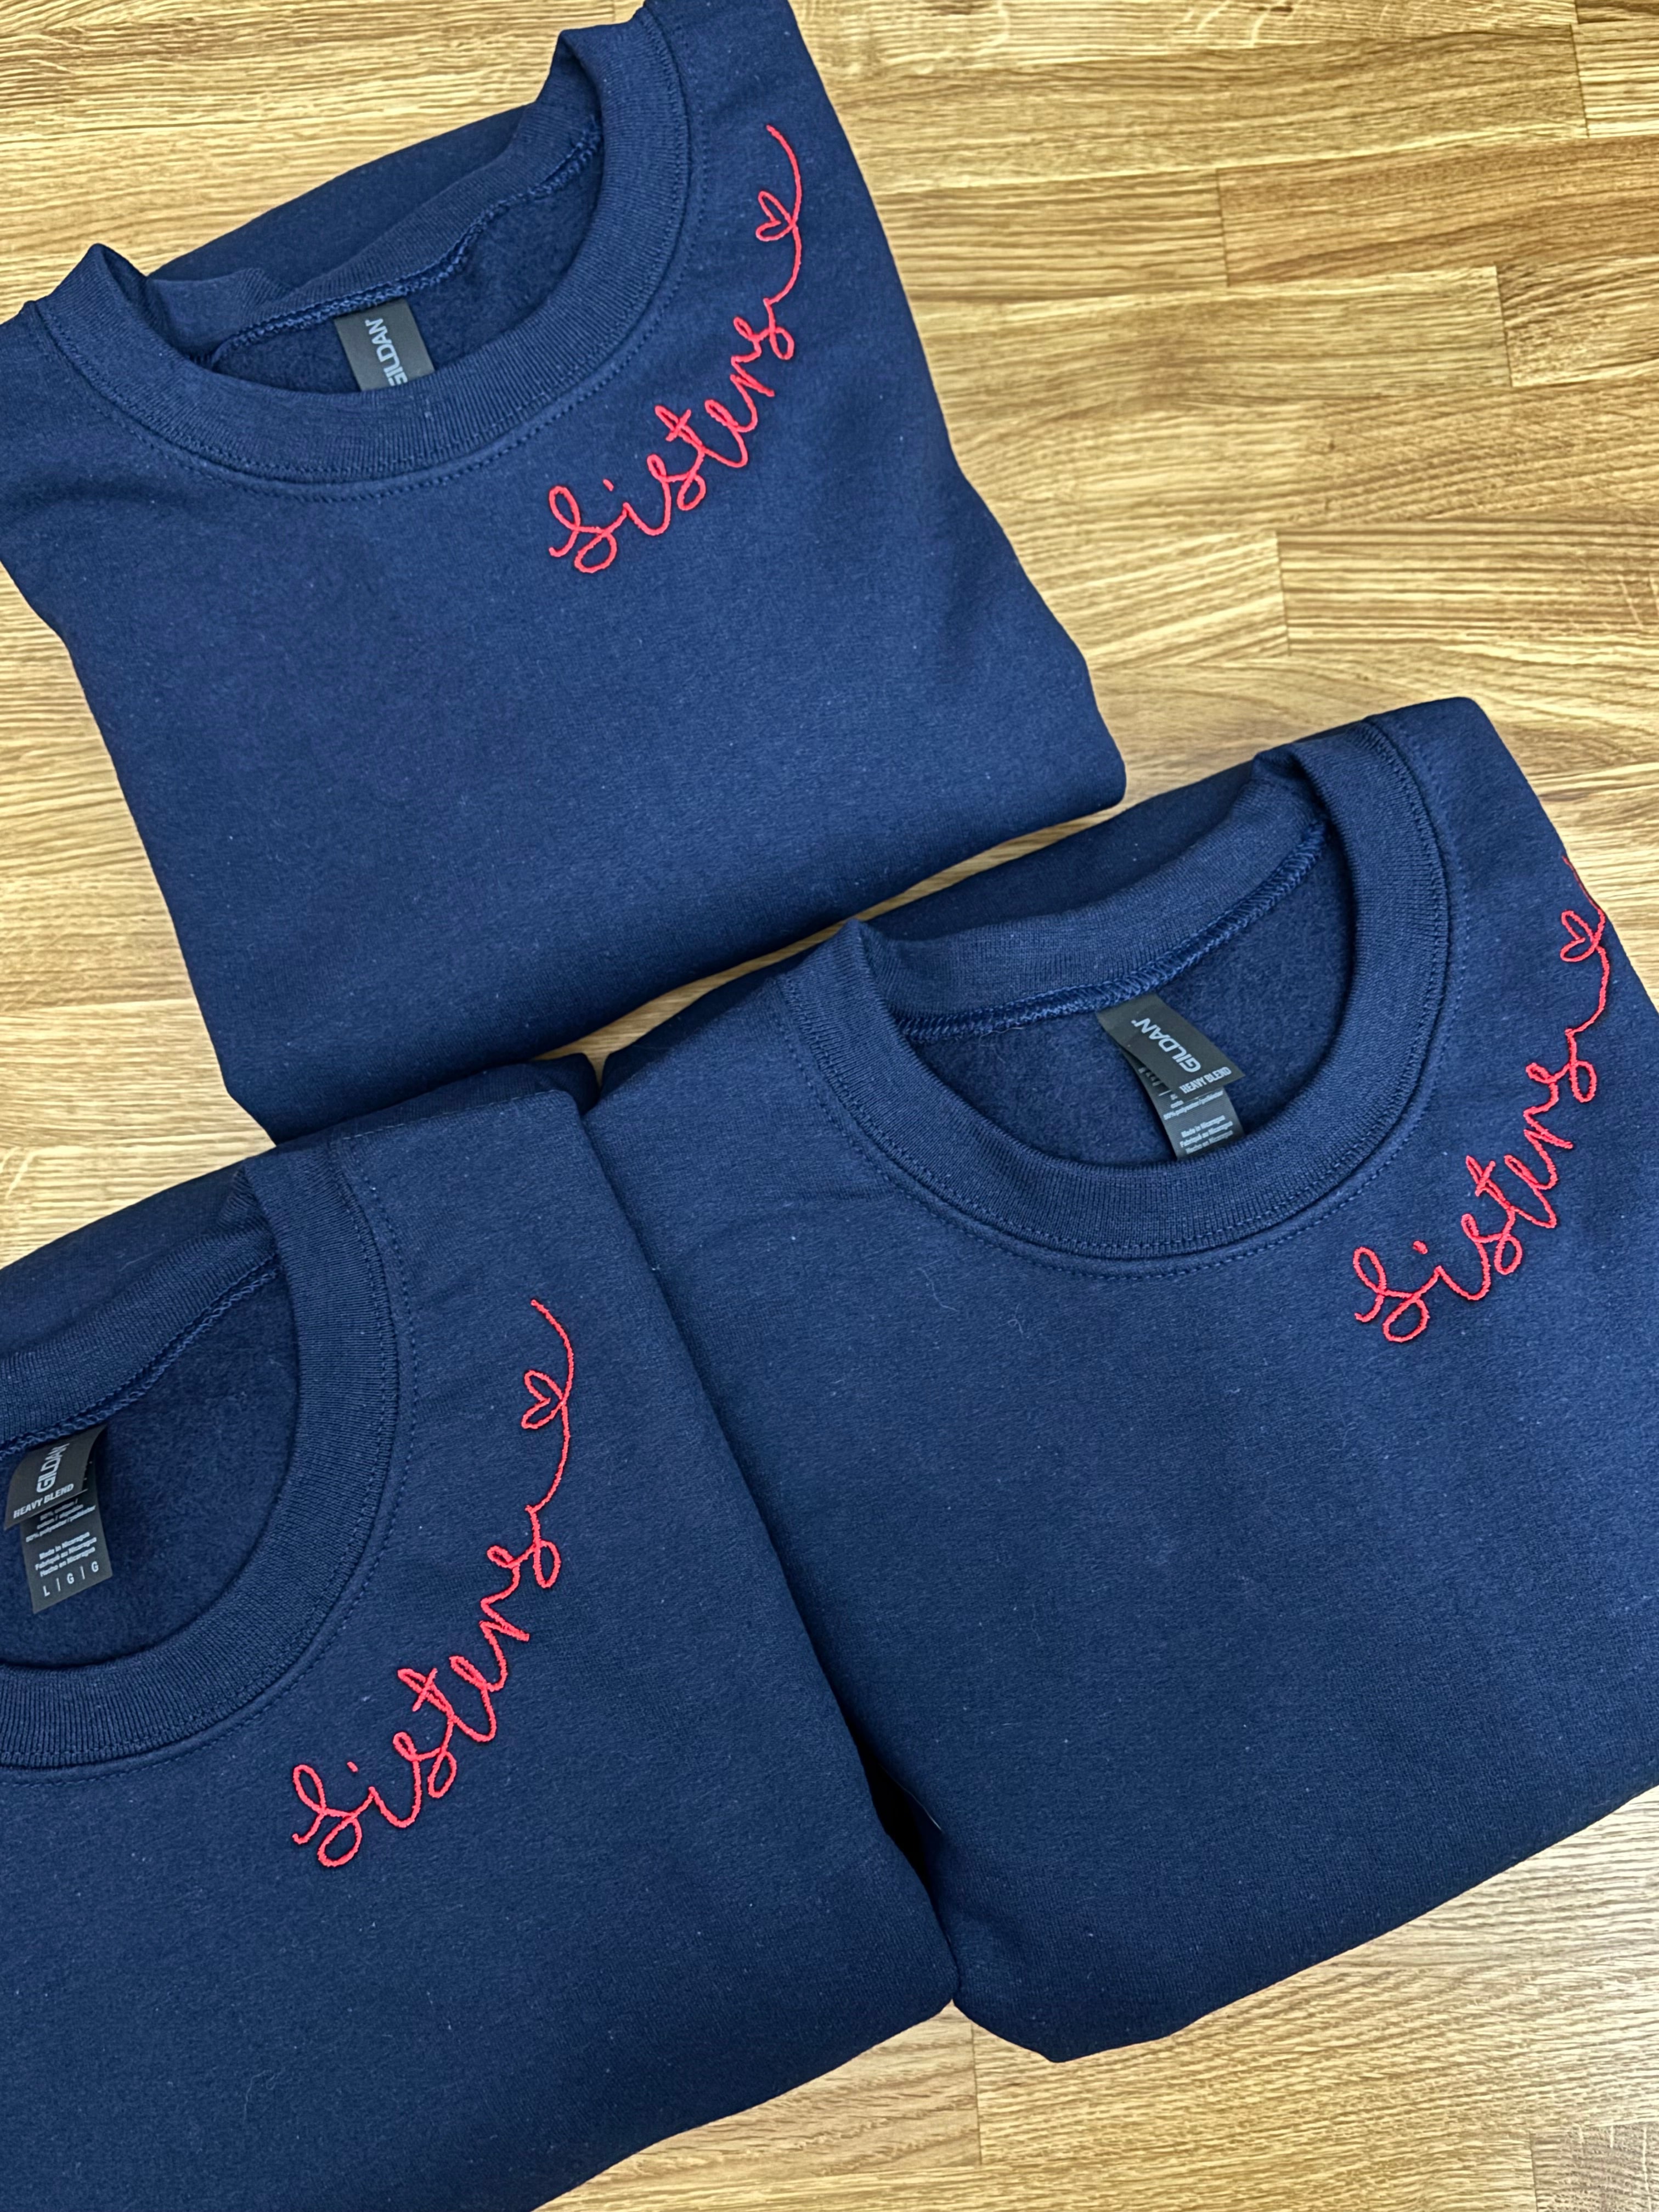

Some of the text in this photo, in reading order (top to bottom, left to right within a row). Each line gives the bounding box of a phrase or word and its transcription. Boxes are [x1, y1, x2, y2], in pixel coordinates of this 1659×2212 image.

[1132, 1018, 1201, 1073] GILDAN
[1179, 1076, 1208, 1094] HEAVY
[1204, 1066, 1232, 1084] BLEND
[36, 1443, 70, 1493] GILDAN
[13, 1483, 74, 1519] HEAVY BLEND
[43, 1585, 50, 1596] L
[67, 1572, 74, 1584] G
[91, 1561, 99, 1572] G
